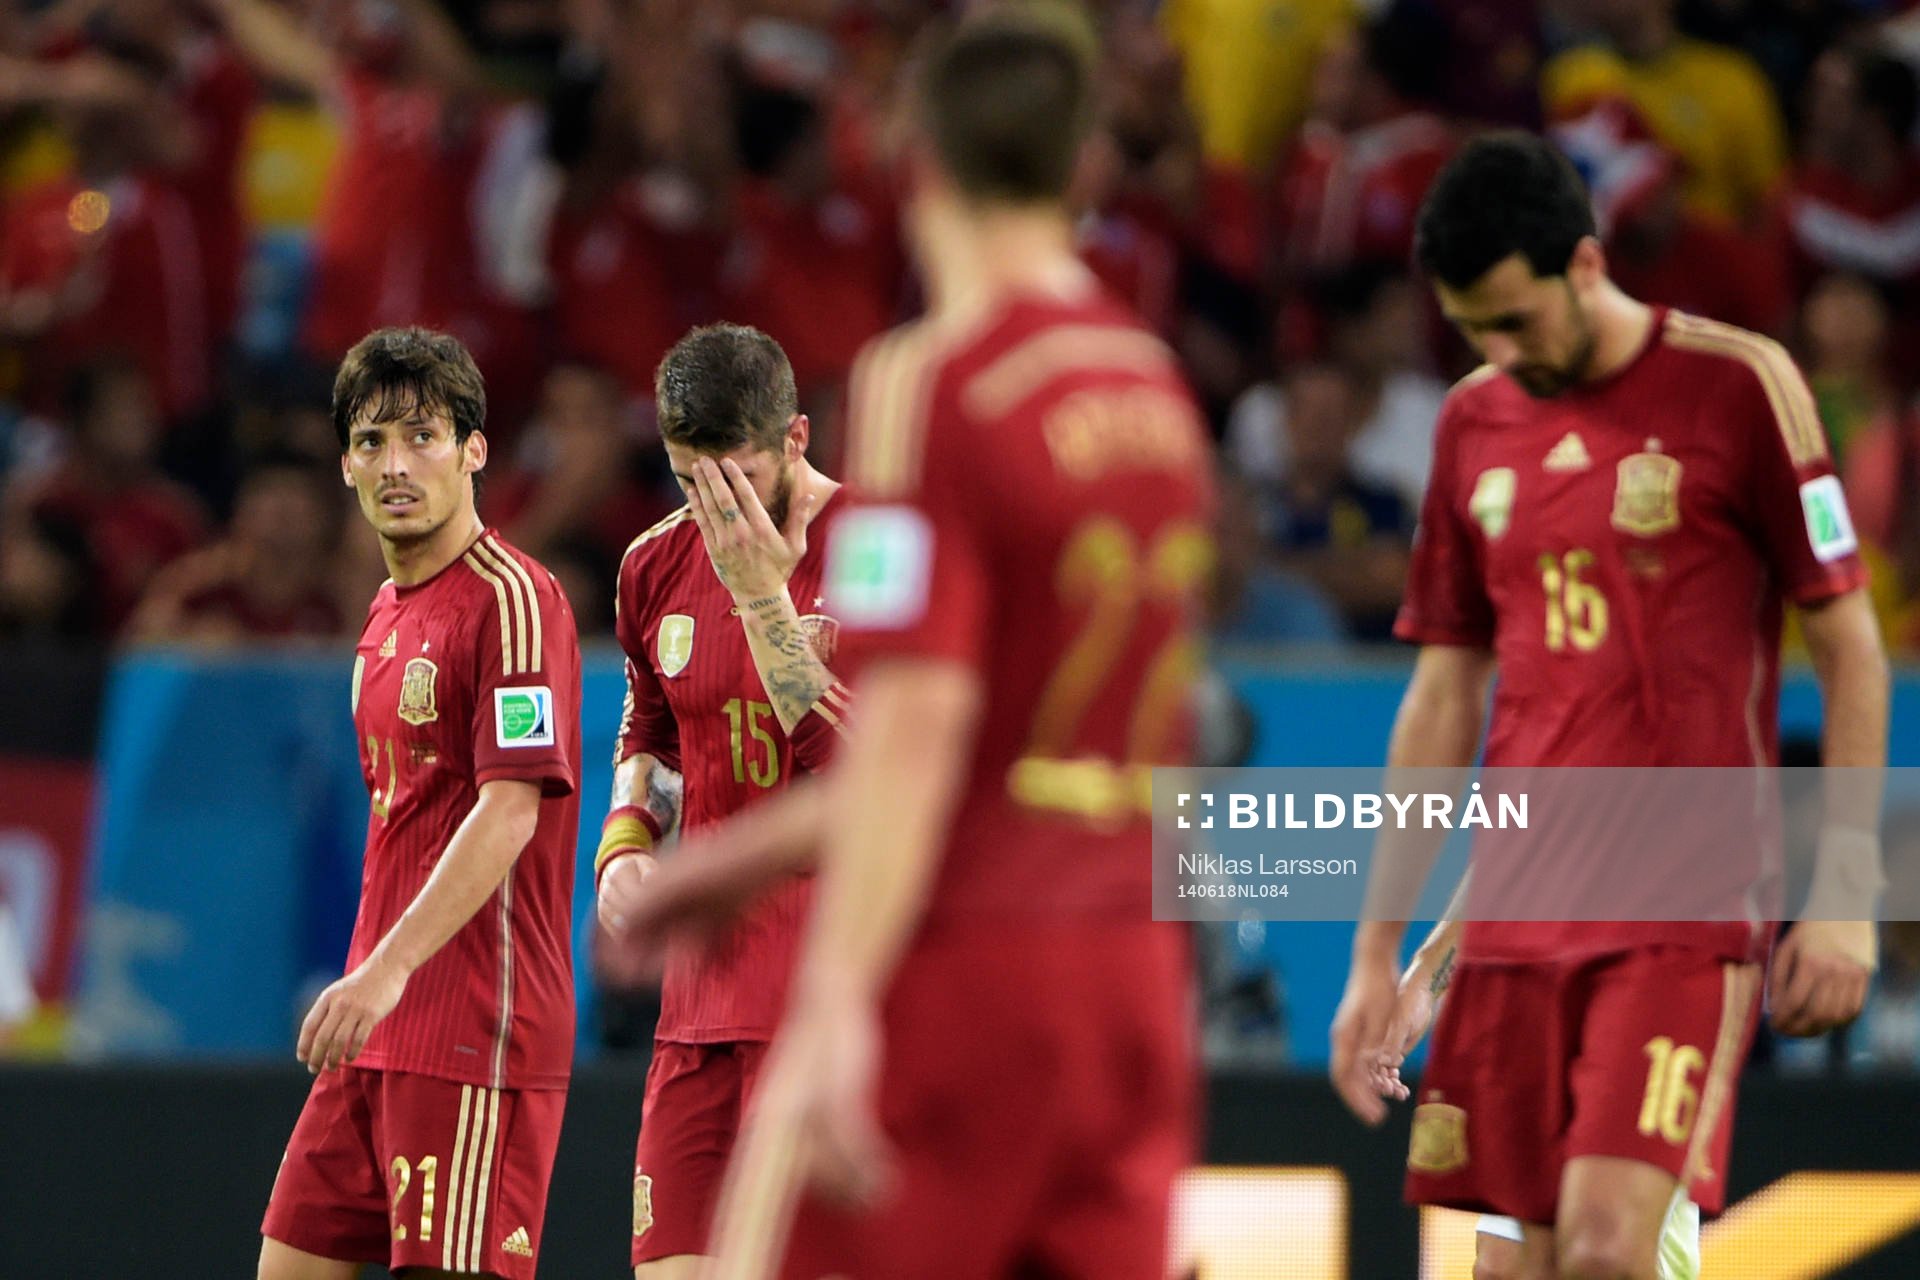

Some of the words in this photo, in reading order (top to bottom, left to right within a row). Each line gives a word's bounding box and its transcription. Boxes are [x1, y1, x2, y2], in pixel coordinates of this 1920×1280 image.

[1539, 550, 1608, 652] 16
[721, 698, 780, 788] 15
[1637, 1035, 1705, 1147] 16
[392, 1156, 438, 1241] 21
